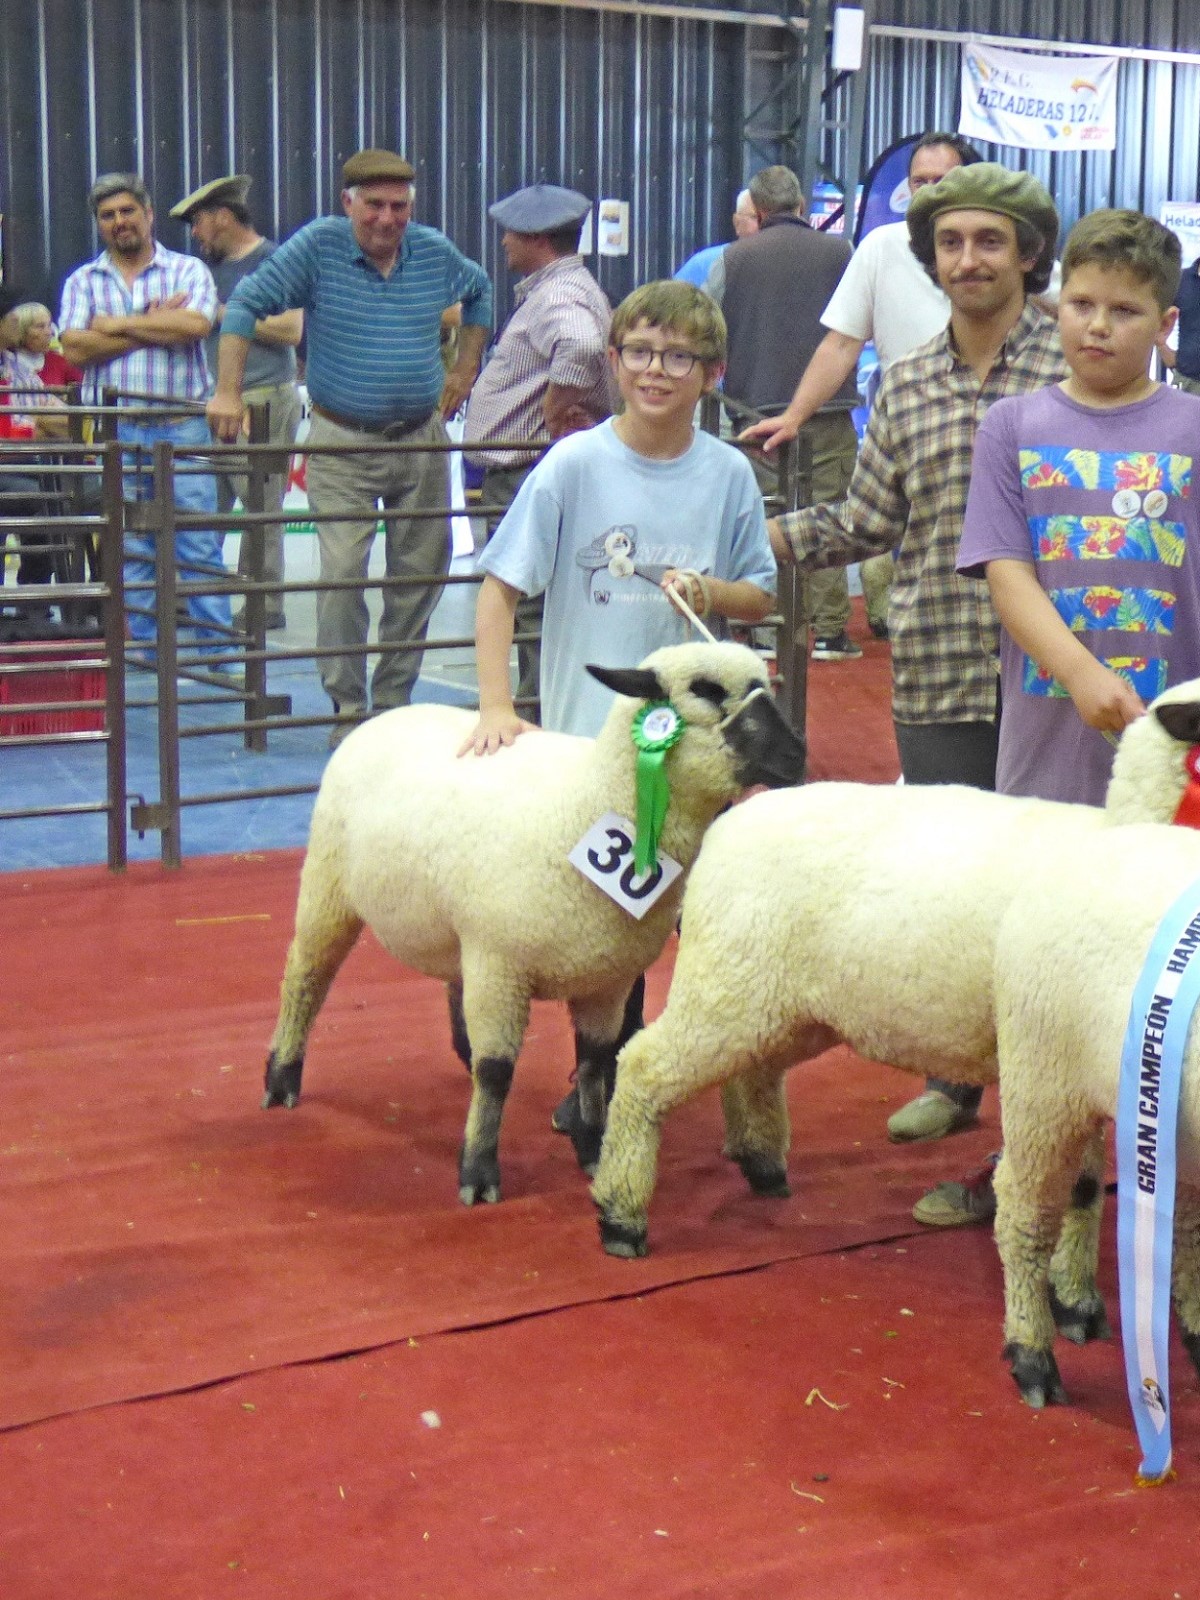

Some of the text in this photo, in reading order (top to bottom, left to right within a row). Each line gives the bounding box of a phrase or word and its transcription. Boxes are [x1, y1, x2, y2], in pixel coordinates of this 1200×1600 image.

[587, 828, 664, 900] 30
[1138, 994, 1174, 1119] CAMPEÓN
[1136, 1123, 1158, 1195] GRAN
